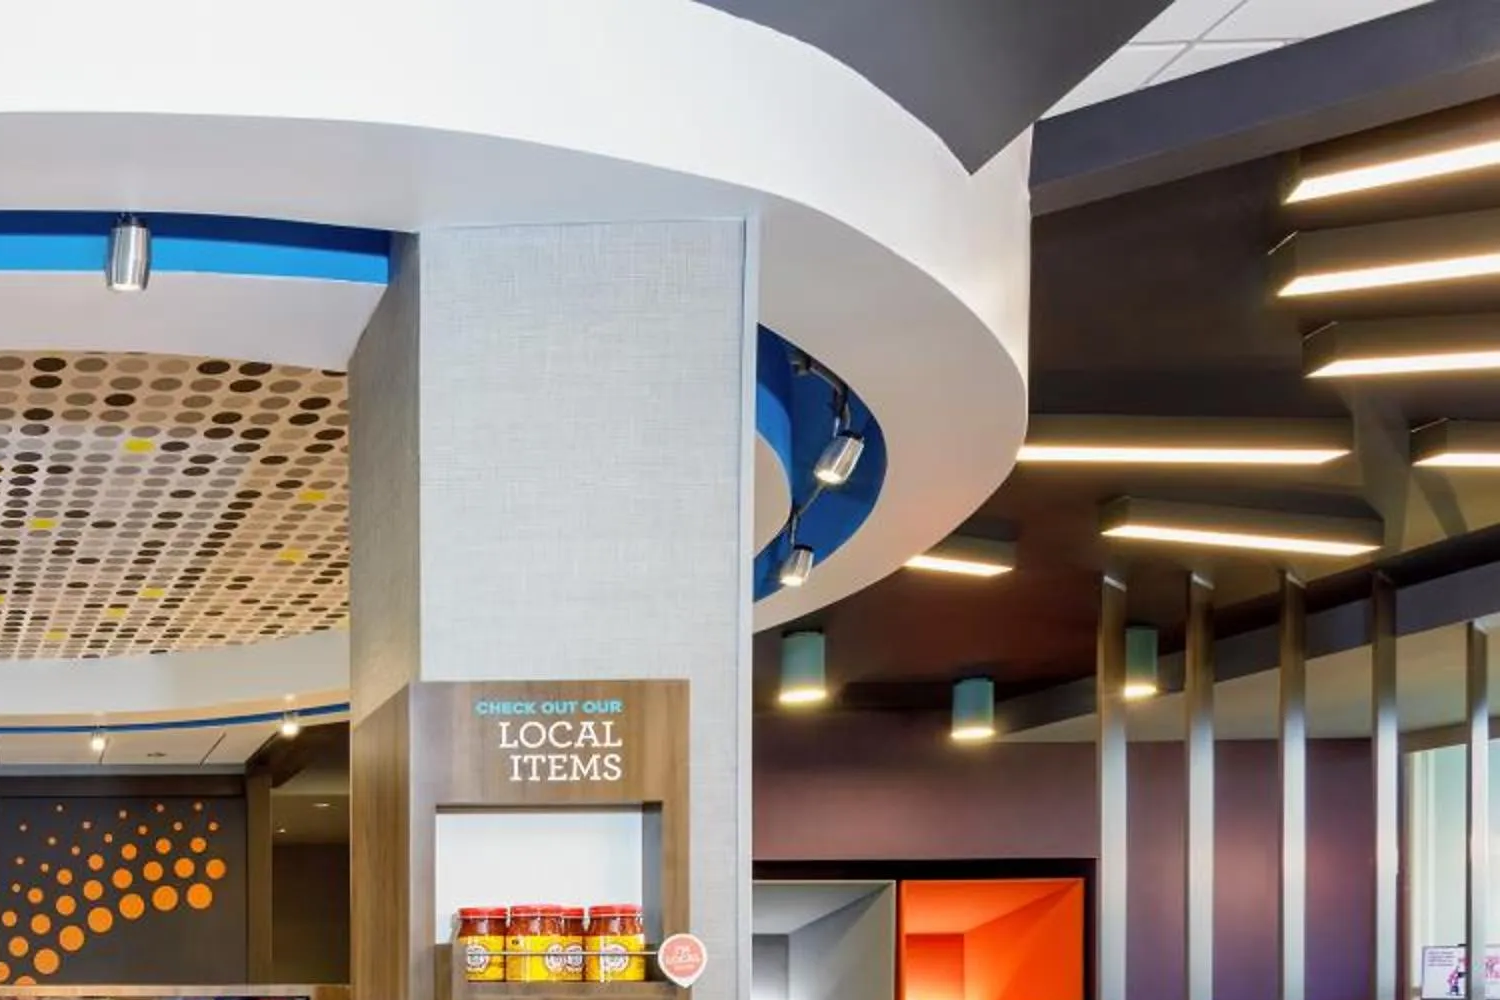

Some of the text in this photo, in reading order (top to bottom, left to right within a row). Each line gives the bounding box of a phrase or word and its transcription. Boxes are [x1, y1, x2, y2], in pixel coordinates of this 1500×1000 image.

[475, 700, 623, 715] CHECK OUT OUR
[499, 721, 623, 749] LOCAL
[509, 754, 622, 782] ITEMS
